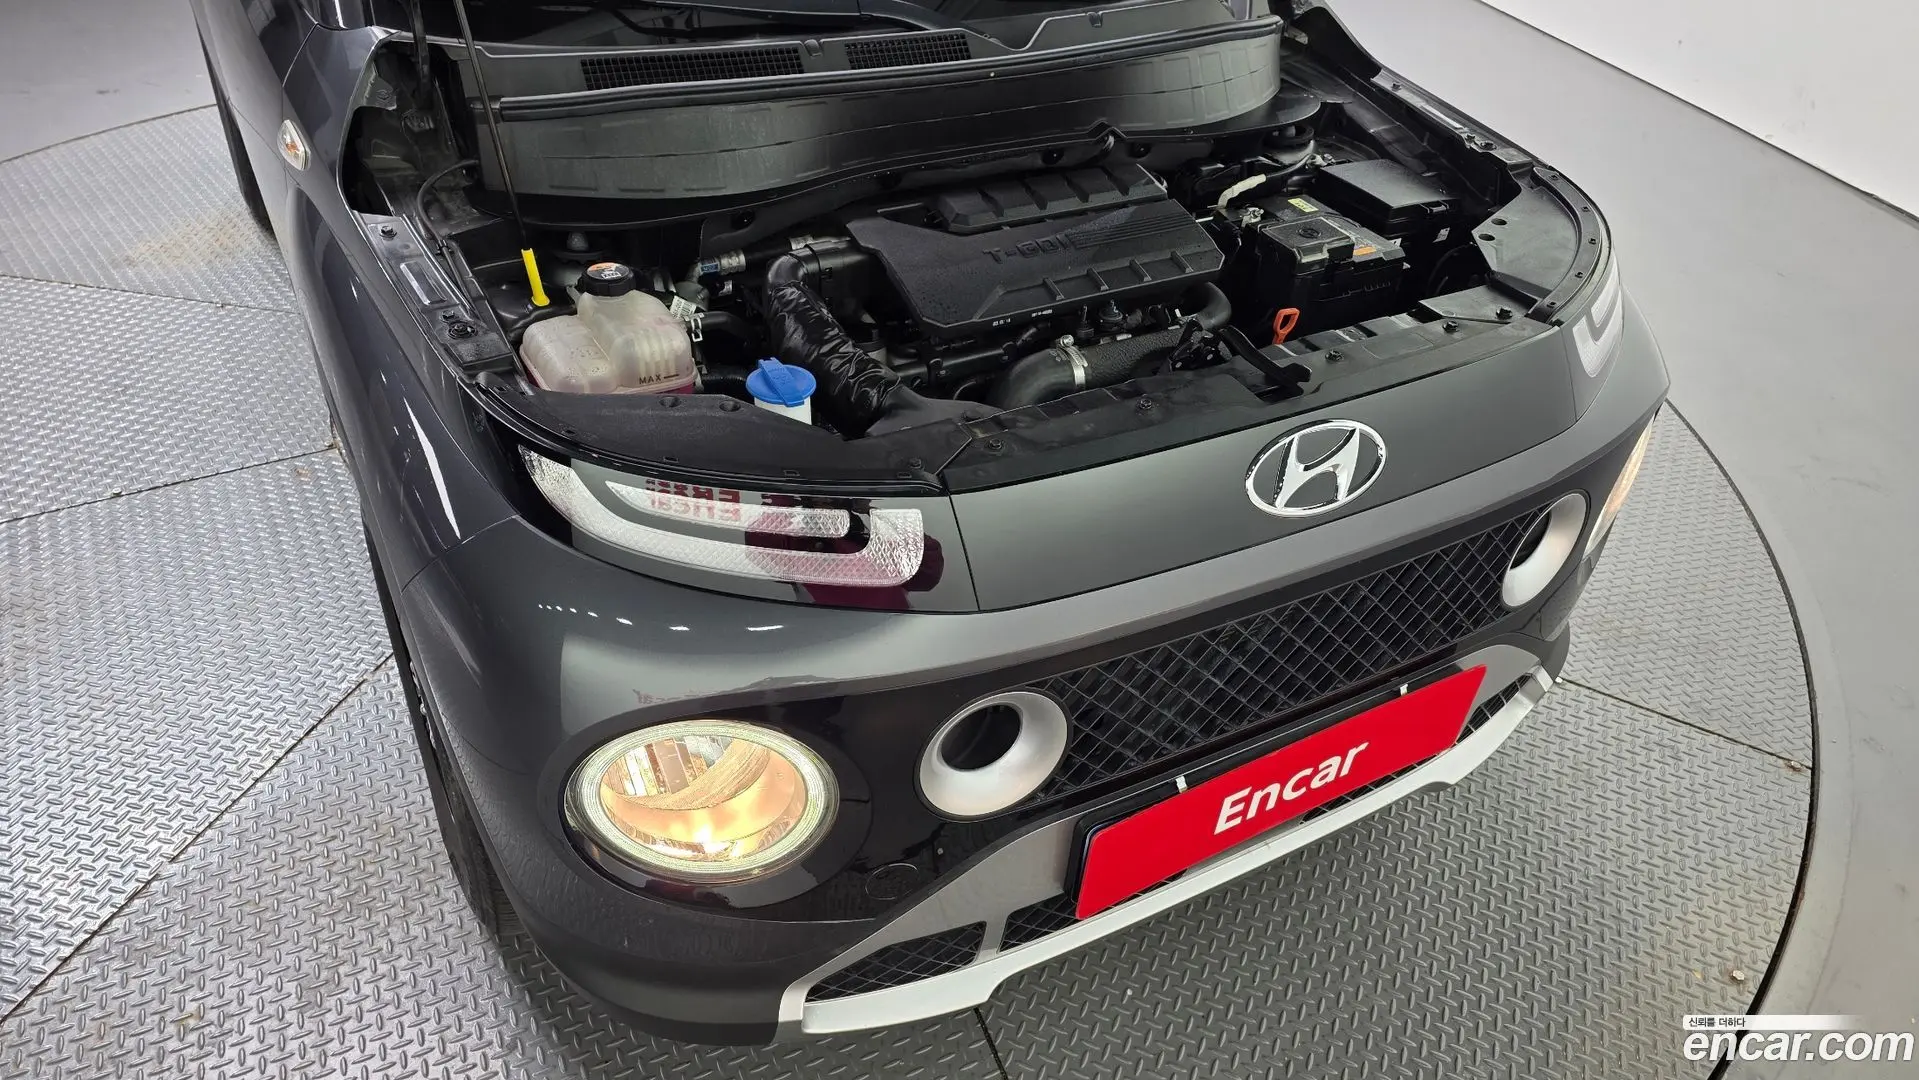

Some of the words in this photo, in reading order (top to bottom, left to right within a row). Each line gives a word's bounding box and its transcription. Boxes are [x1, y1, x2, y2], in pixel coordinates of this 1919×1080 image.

[982, 233, 1067, 265] T-GDI
[639, 373, 662, 385] MAX
[1213, 741, 1369, 836] Encar
